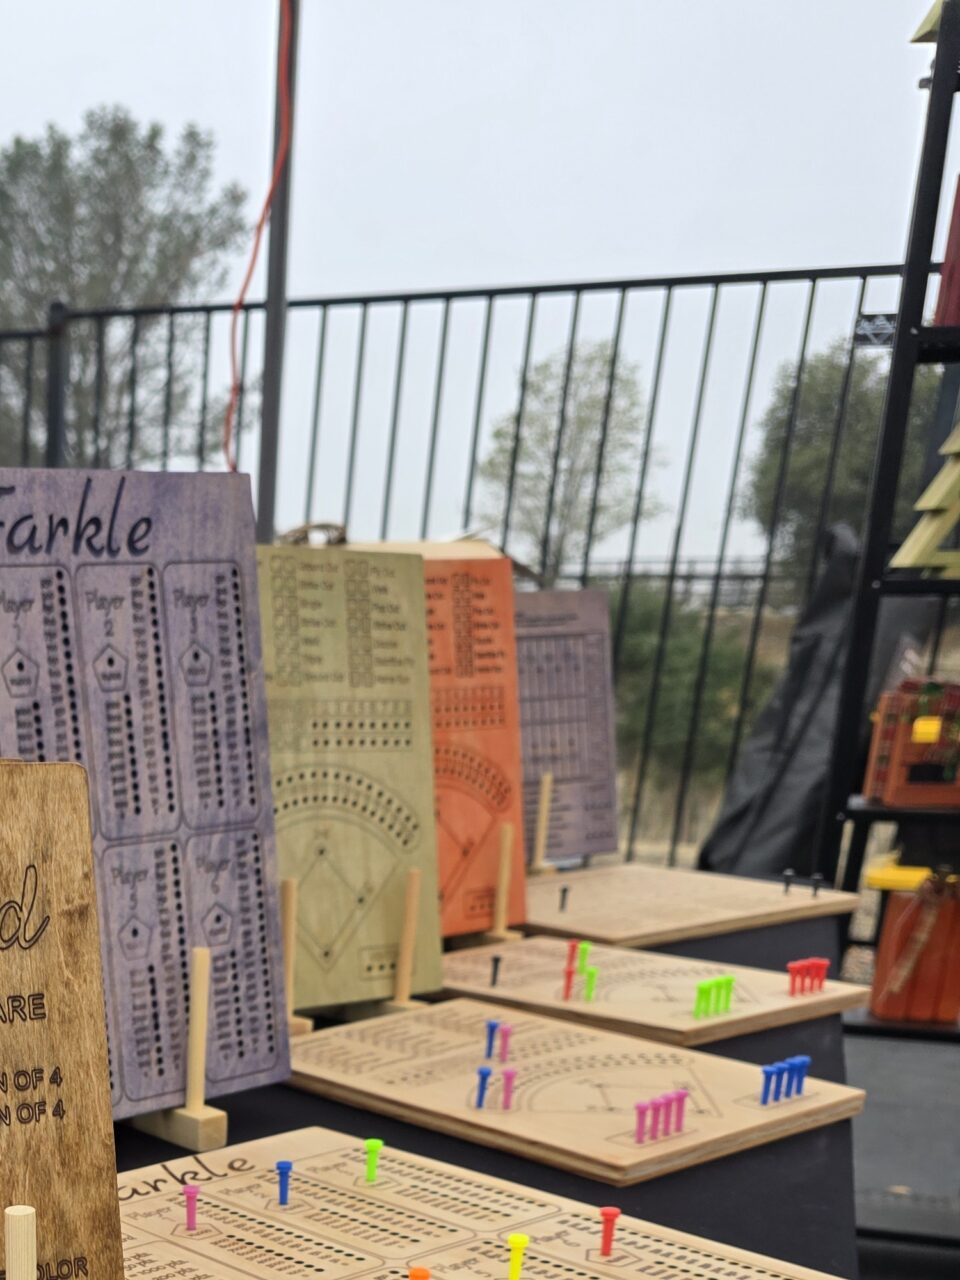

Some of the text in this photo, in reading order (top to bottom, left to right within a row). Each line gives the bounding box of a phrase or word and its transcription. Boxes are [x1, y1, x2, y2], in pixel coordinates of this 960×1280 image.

[86, 588, 124, 617] Player
[104, 620, 114, 637] 2
[13, 1068, 44, 1092] OF
[50, 1066, 63, 1087] 4
[118, 1155, 255, 1201] arkle
